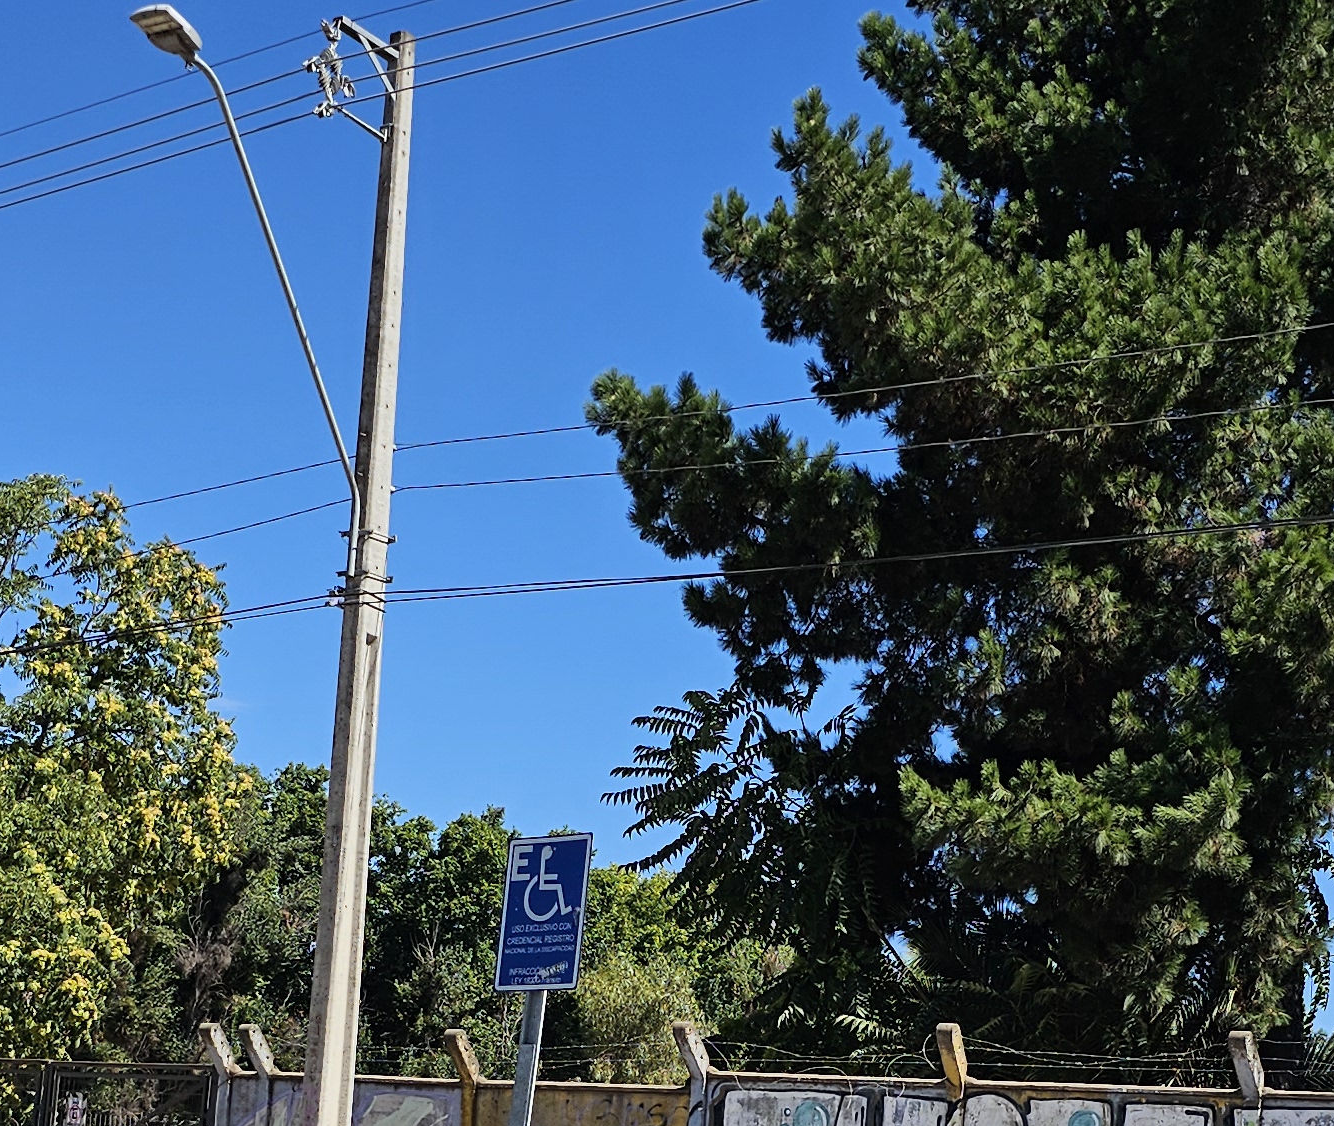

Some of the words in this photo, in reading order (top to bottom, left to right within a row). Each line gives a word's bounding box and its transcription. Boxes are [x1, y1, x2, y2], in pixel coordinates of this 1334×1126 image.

[511, 845, 533, 881] E
[511, 924, 525, 934] USO
[525, 923, 558, 932] EXCLUSIVO
[558, 922, 572, 931] CON
[506, 935, 543, 945] CREDENCIAL
[544, 934, 575, 944] REGISTRO
